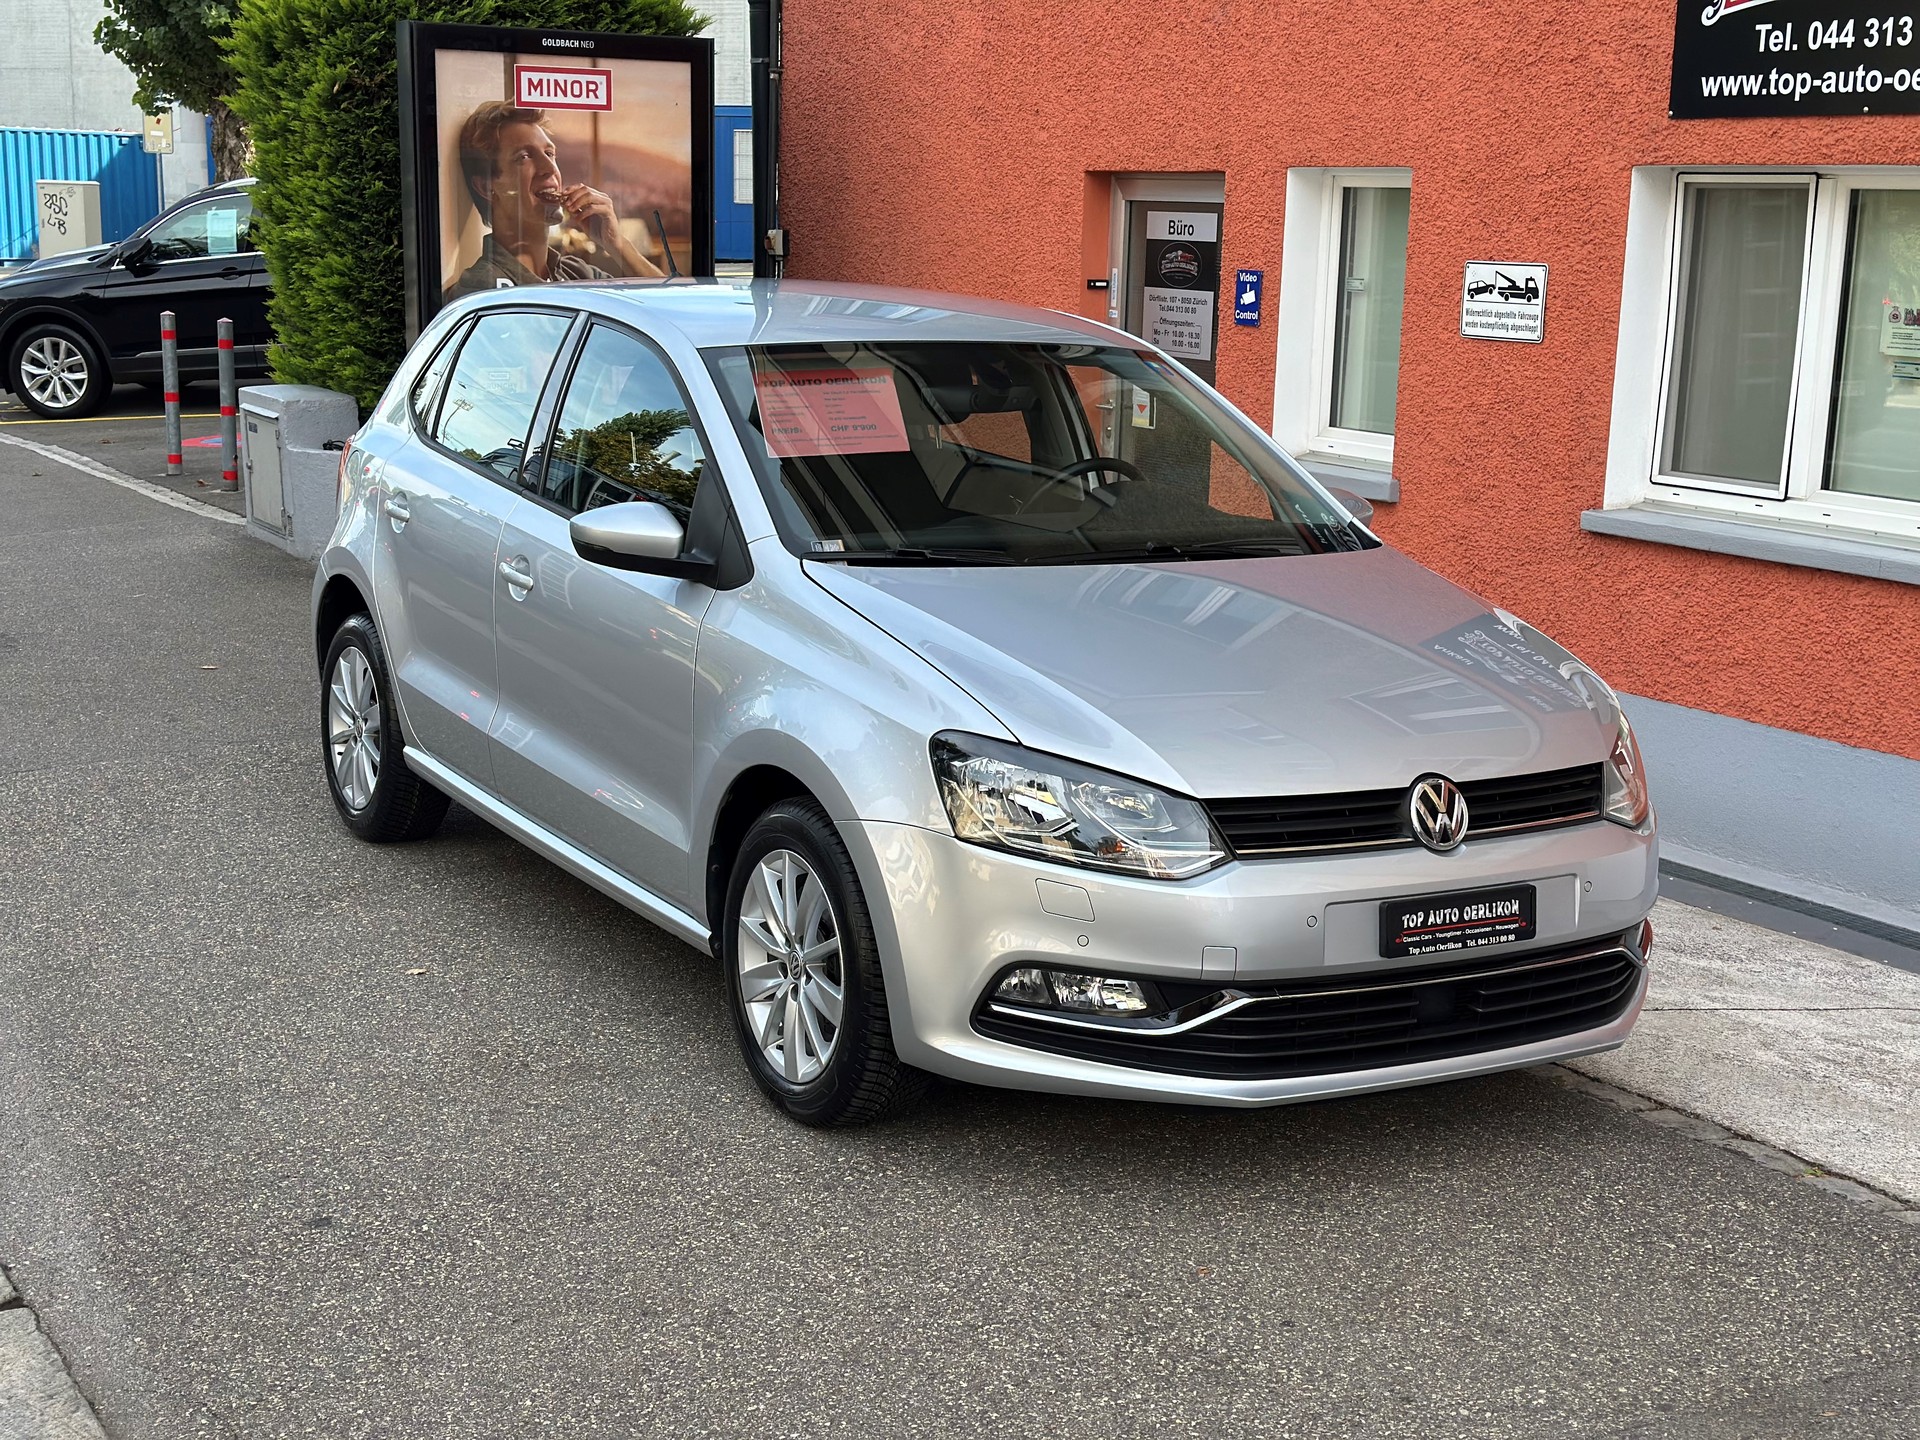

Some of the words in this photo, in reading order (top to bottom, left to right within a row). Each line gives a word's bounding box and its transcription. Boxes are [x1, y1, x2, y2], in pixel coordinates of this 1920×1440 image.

[1755, 22, 1798, 53] Tel.
[1807, 18, 1856, 51] 044
[1863, 15, 1914, 48] 313
[542, 38, 579, 48] GOLDBACH
[580, 40, 595, 49] NEO
[527, 77, 600, 99] MINOR
[1168, 219, 1195, 236] Büro
[1239, 272, 1258, 283] Video
[1192, 297, 1208, 306] Zürich
[1175, 305, 1184, 313] 313
[1235, 309, 1259, 320] Control
[763, 379, 786, 388] TOP
[789, 378, 823, 387] AUTO
[825, 376, 887, 386] OERLIKON
[830, 424, 849, 432] CHF
[1411, 778, 1469, 851] VW
[1401, 911, 1425, 929] TOP
[1427, 907, 1459, 926] AUTO
[1463, 899, 1520, 921] OERLIKON
[1403, 935, 1421, 943] Classic
[1435, 930, 1462, 938] Youngtimer
[1465, 926, 1493, 935] Occasionen
[1409, 947, 1421, 956] Top
[1421, 945, 1436, 953] Auto
[1436, 942, 1462, 951] Oerlikon
[1466, 939, 1477, 947] Tel.
[1477, 937, 1488, 946] 044
[1488, 935, 1500, 944] 313
[1500, 934, 1508, 943] 00
[1508, 933, 1516, 942] 80
